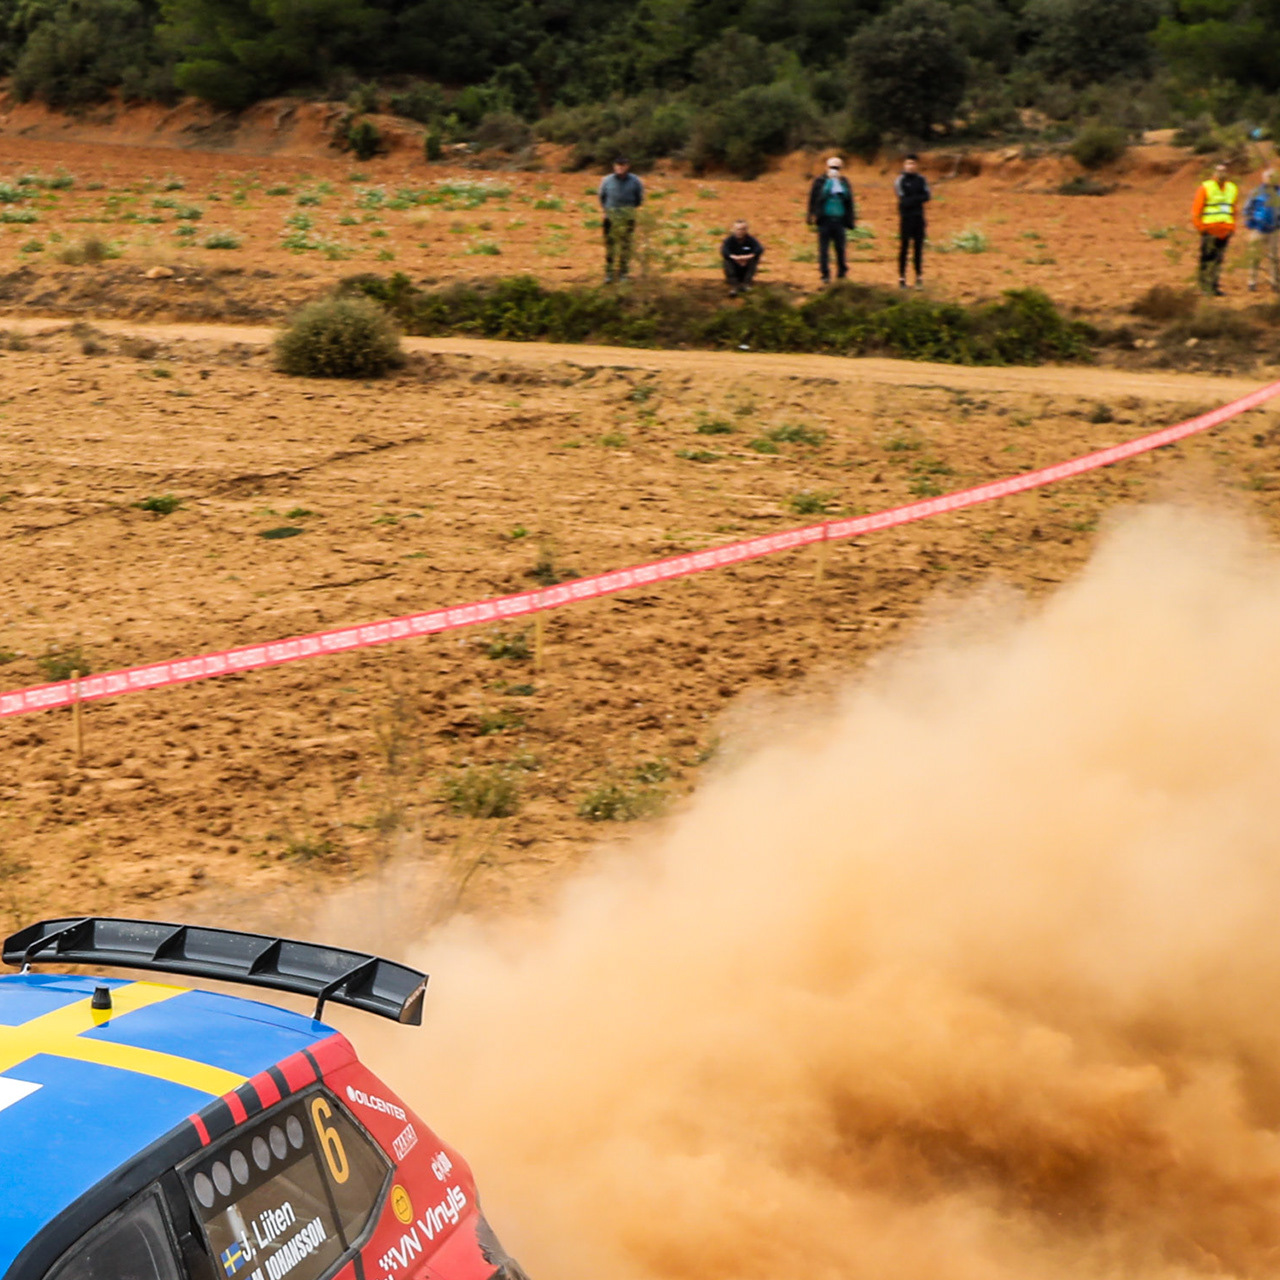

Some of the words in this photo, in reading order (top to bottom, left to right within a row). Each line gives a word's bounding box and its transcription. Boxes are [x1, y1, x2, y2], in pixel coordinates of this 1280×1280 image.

[310, 1097, 350, 1184] 6
[355, 1089, 408, 1123] OILCENTER
[240, 1230, 257, 1263] J.
[251, 1200, 297, 1250] Liiten
[391, 1226, 423, 1268] VN
[416, 1185, 467, 1241] Vinyls
